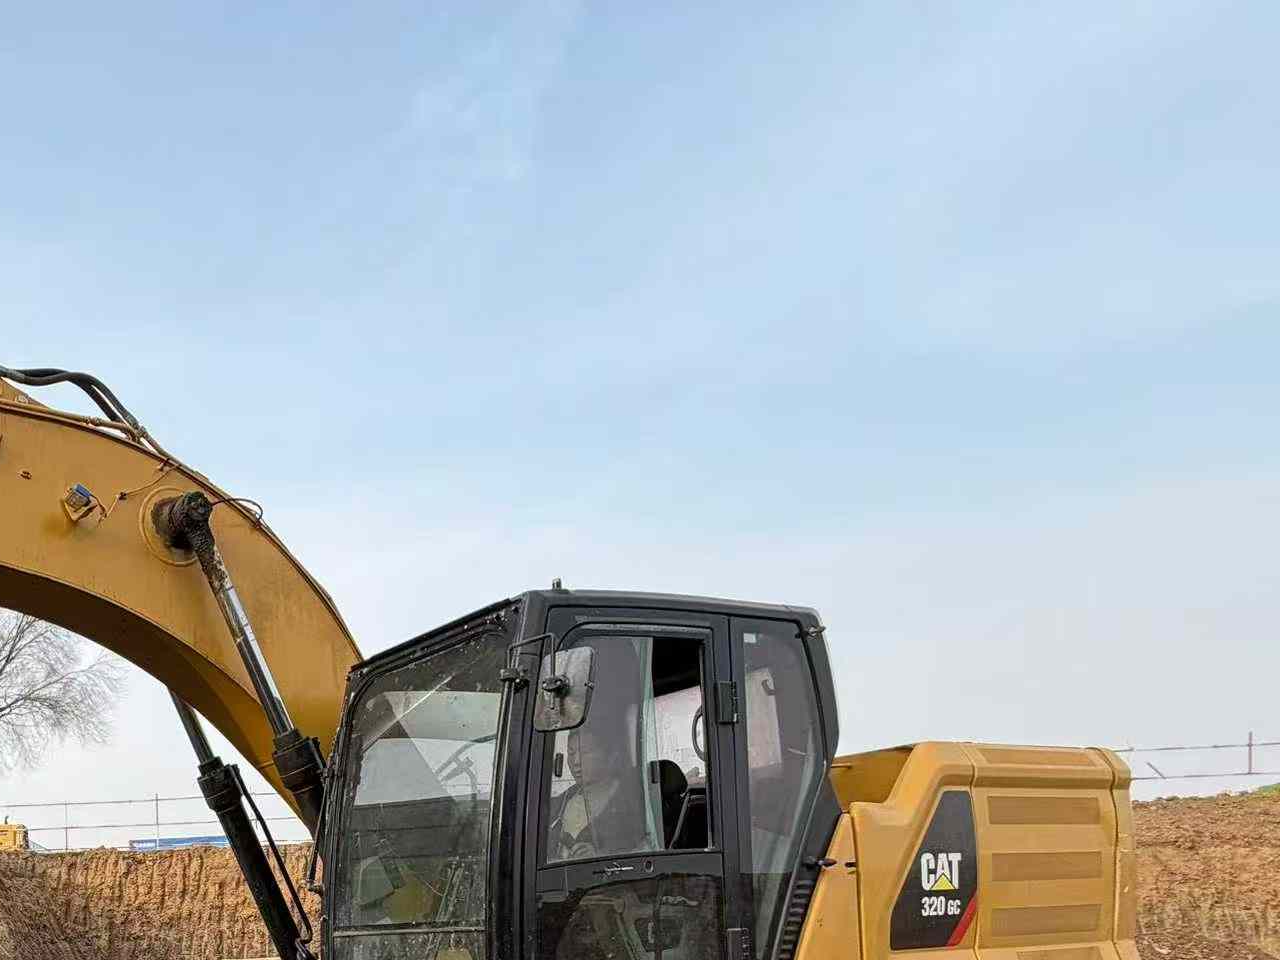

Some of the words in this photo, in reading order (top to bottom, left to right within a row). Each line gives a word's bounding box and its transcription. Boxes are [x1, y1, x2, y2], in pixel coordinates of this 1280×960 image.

[920, 852, 962, 891] CAT
[921, 895, 945, 917] 320
[947, 899, 961, 915] GC
